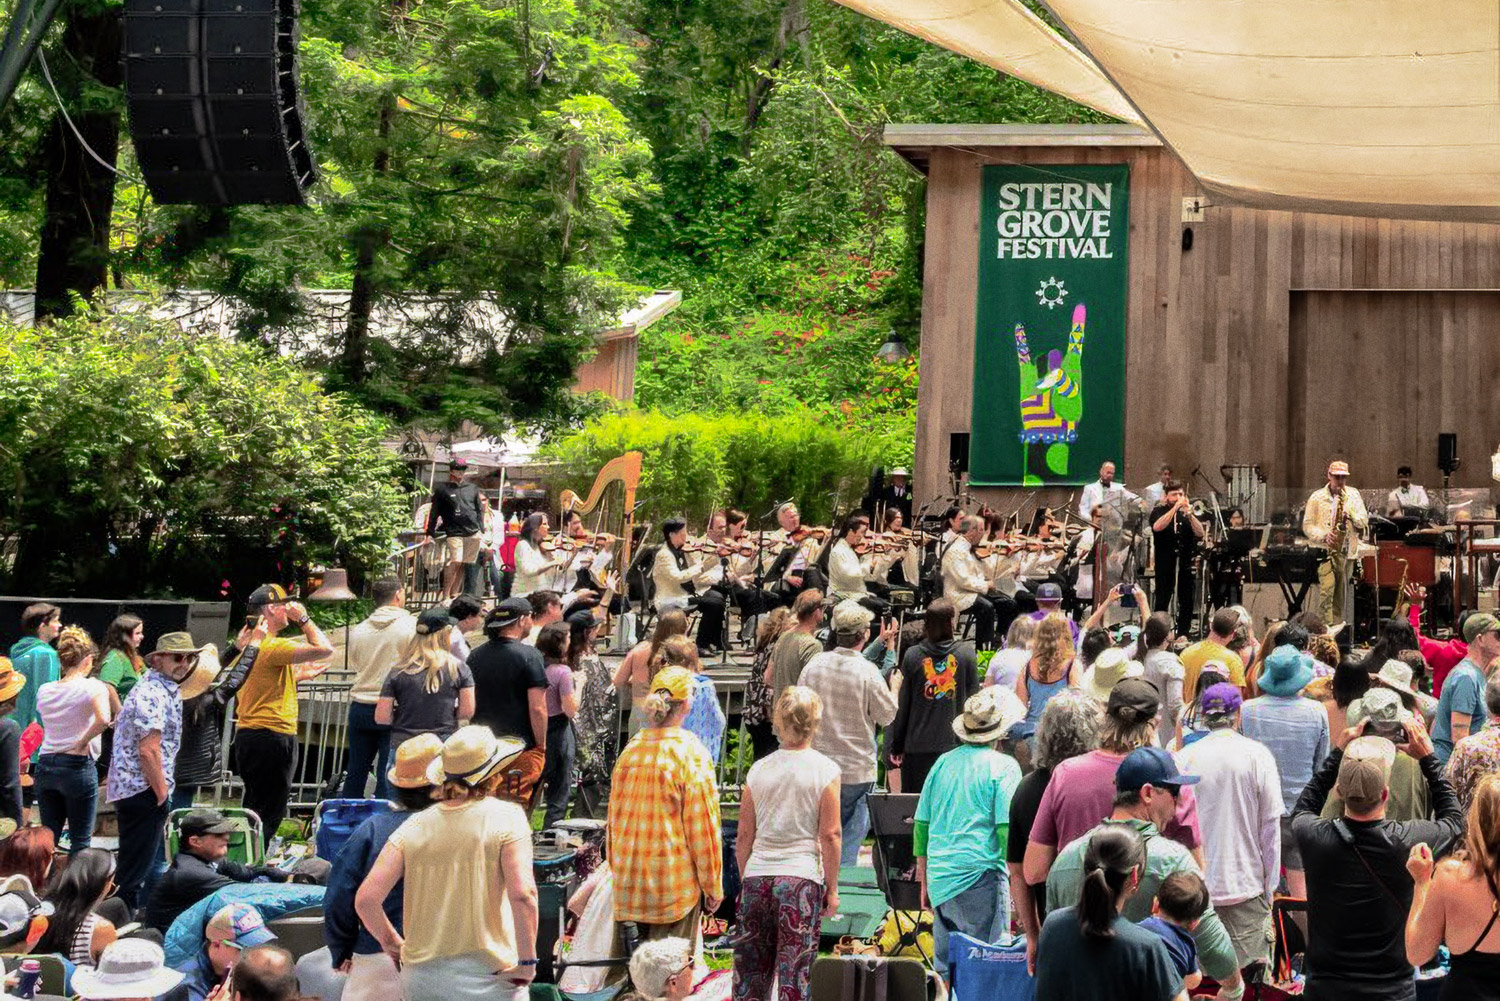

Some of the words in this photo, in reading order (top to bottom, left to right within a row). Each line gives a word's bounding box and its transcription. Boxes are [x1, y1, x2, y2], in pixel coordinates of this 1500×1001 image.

[999, 182, 1112, 210] STERN
[997, 210, 1111, 238] GROVE
[997, 238, 1113, 259] FESTIVAL
